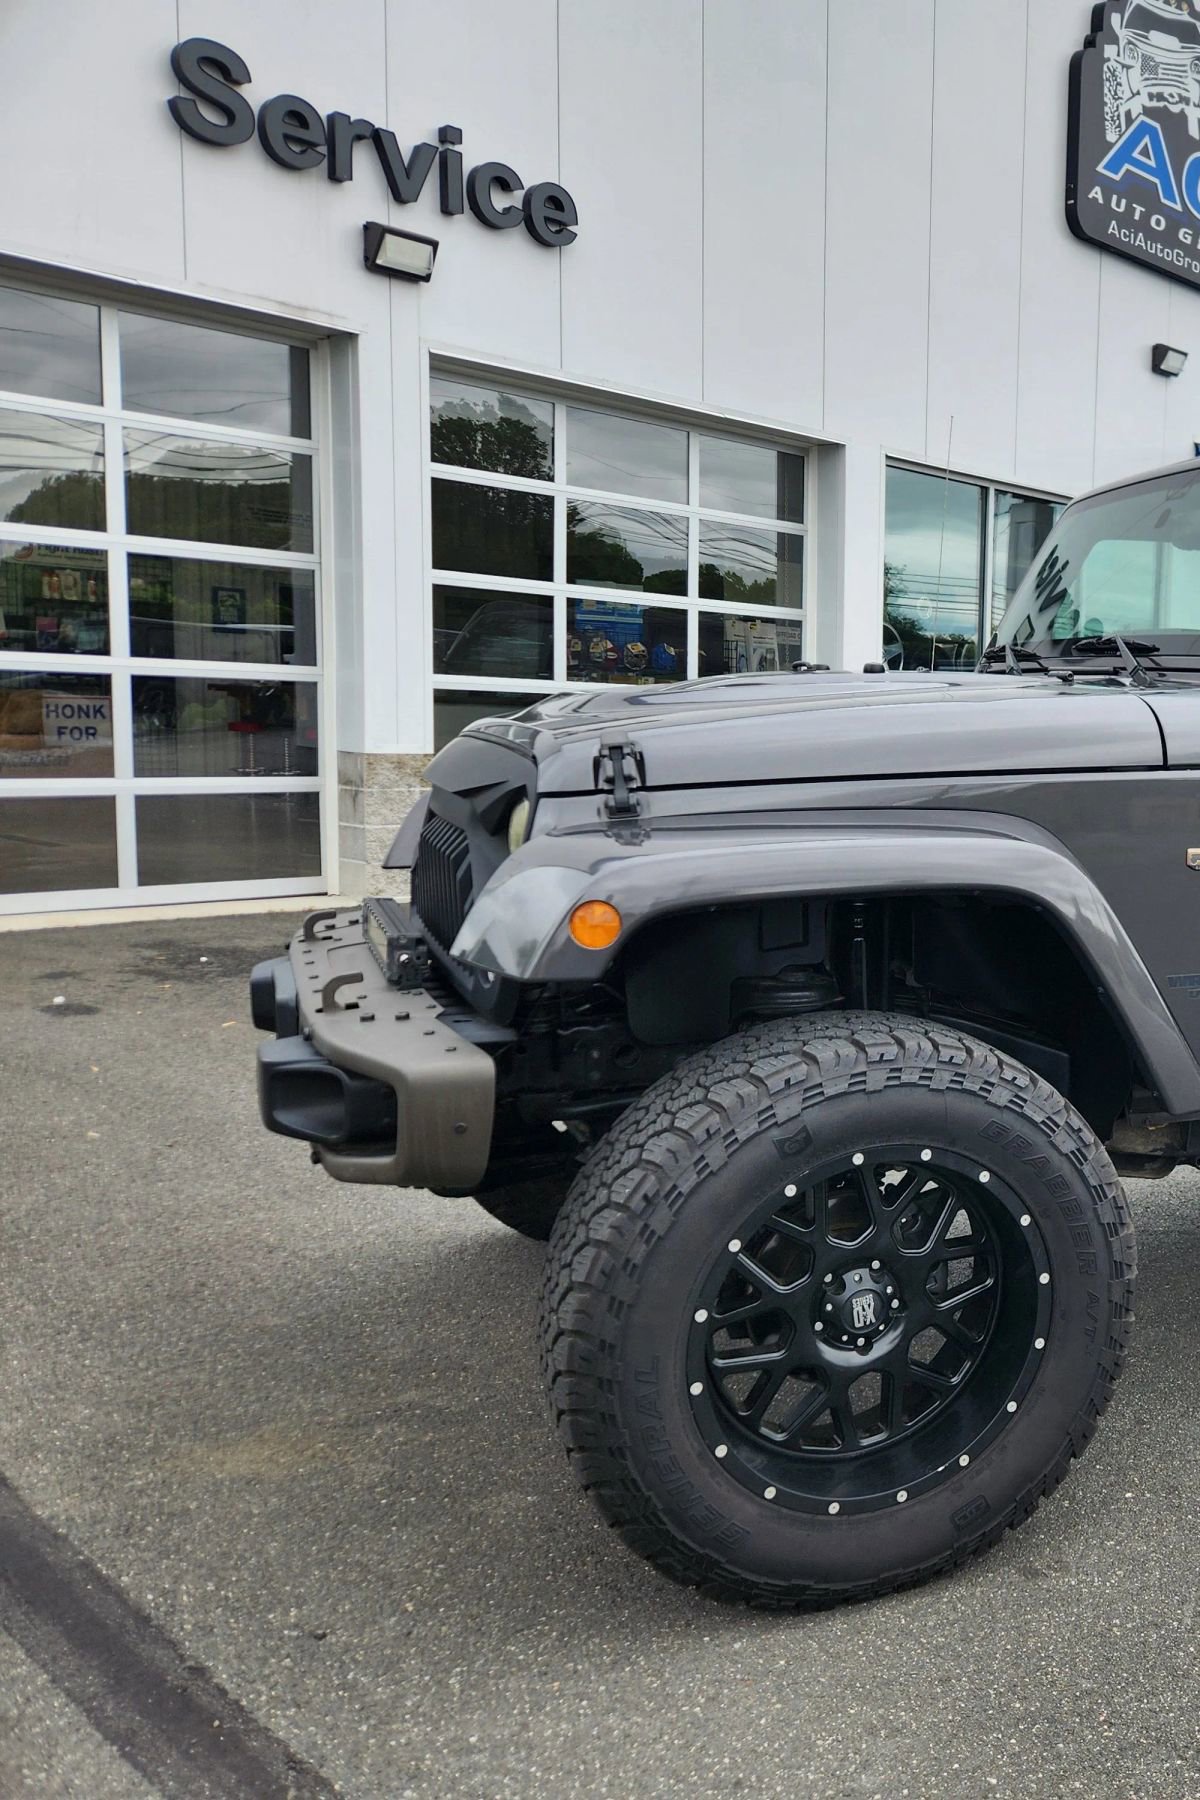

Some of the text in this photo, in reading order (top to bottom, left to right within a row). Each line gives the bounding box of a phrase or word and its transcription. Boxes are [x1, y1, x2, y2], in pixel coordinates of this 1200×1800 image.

[166, 37, 579, 248] Service
[1087, 185, 1167, 231] AUTO
[45, 703, 107, 720] HONK
[56, 725, 98, 741] FOR
